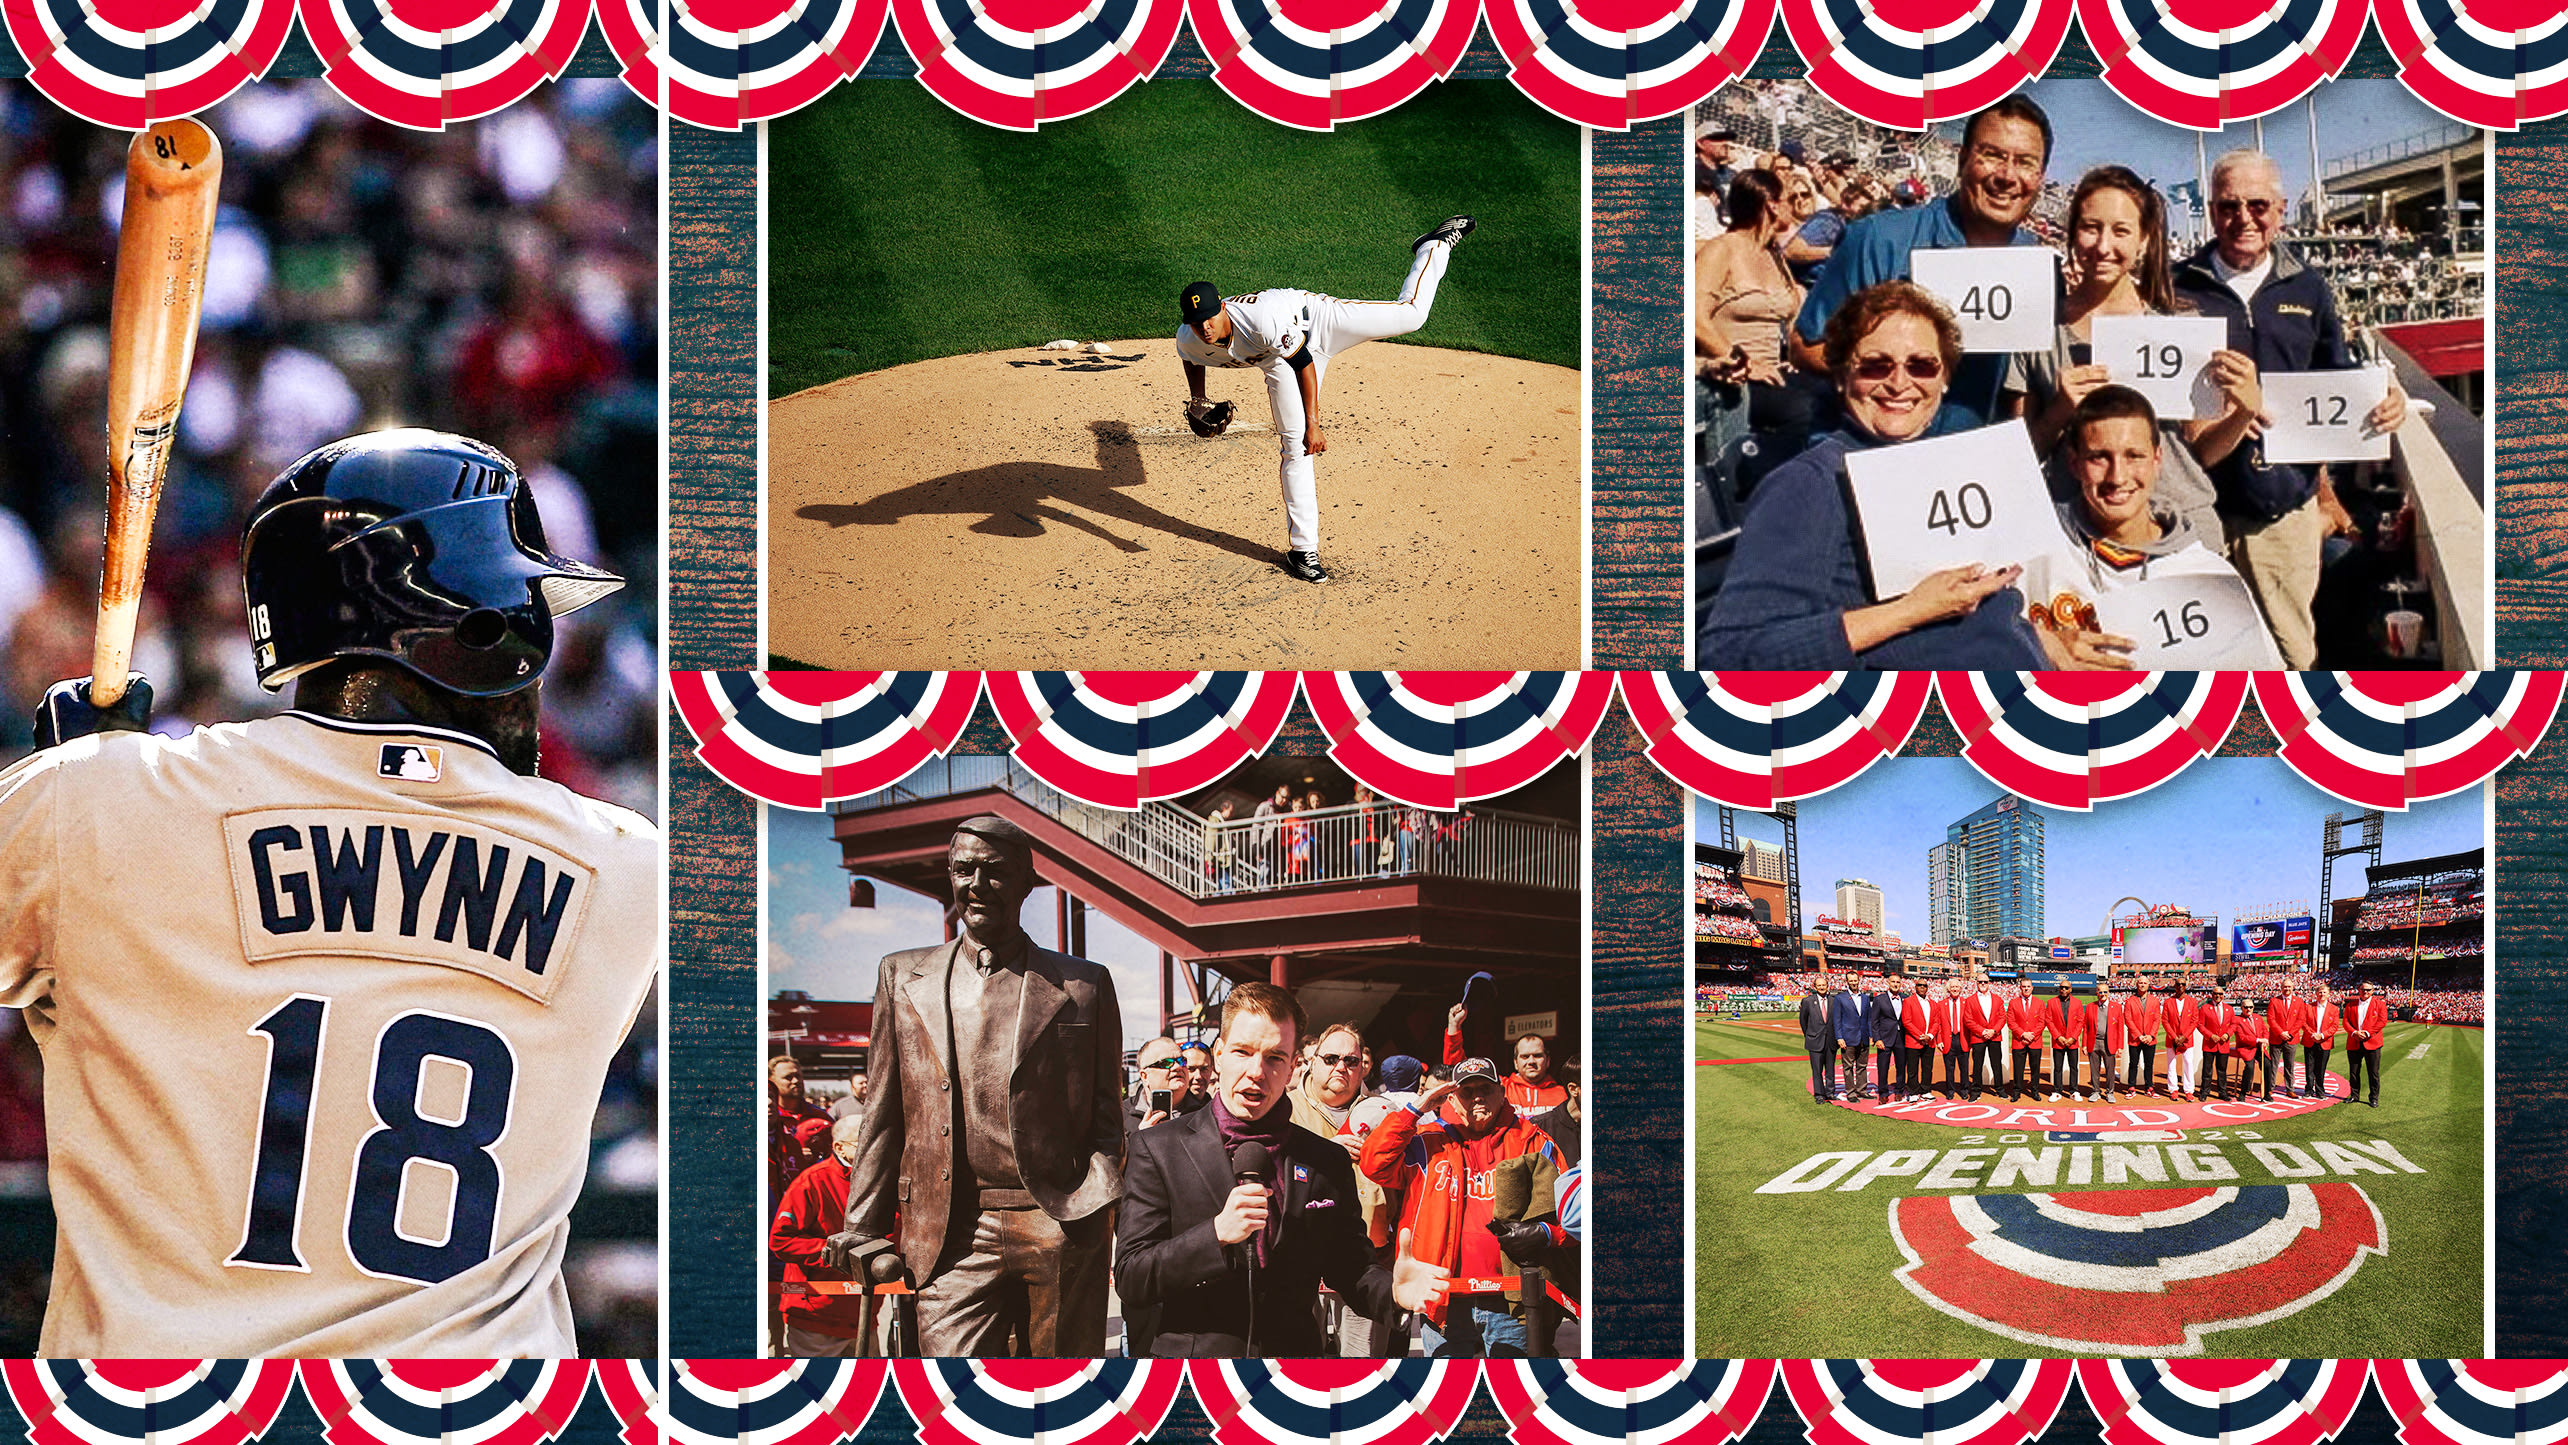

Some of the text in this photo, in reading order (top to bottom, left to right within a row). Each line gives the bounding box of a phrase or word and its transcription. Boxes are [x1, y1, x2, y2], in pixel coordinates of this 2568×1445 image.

[1191, 294, 1201, 309] P
[1960, 285, 2013, 321] 40
[2135, 344, 2183, 379] 19
[2304, 396, 2348, 426] 12
[1926, 482, 1993, 536] 40
[250, 603, 272, 642] 18
[2152, 600, 2209, 648] 16
[248, 824, 575, 977] GWYNN
[1517, 1018, 1553, 1032] ELEVATORS
[1872, 1096, 2182, 1127] WORLD
[223, 992, 519, 1288] 18
[1957, 1130, 2264, 1145] 20 23
[1753, 1139, 2428, 1194] OPENING DAY
[842, 1282, 863, 1294] Phill
[1468, 1278, 1502, 1292] Phillies
